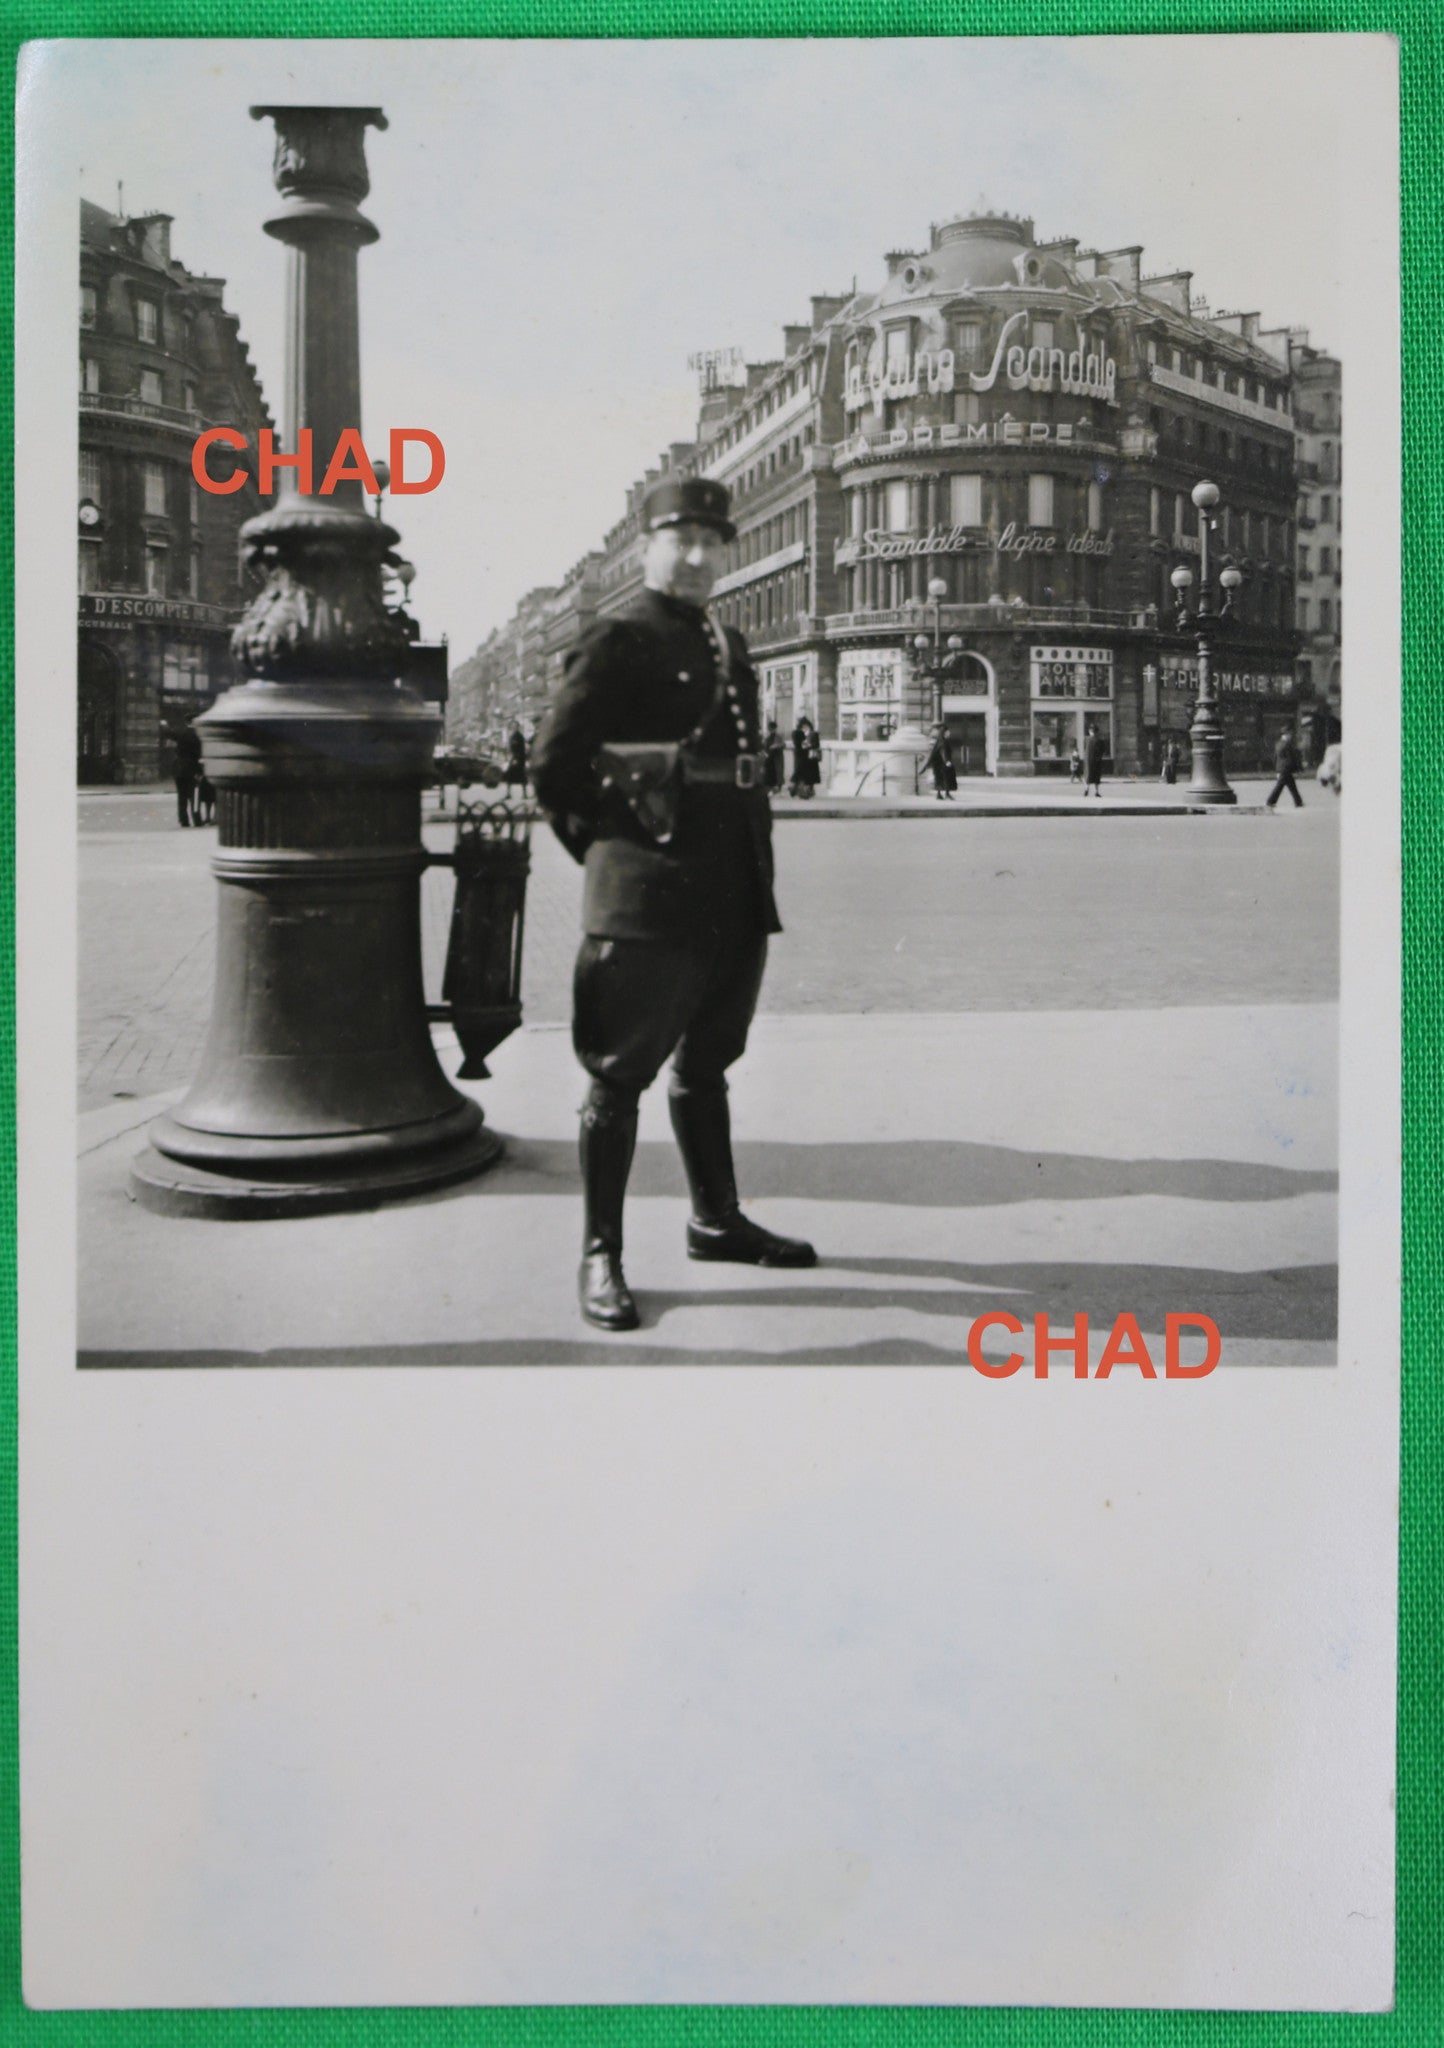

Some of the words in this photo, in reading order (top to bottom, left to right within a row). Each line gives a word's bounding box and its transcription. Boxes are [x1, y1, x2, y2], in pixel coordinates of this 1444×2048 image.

[969, 309, 1116, 400] Scandale
[860, 522, 967, 560] Scandale
[997, 521, 1056, 562] ligne
[95, 598, 190, 619] D'ESCOMPTE
[1039, 663, 1110, 677] HOLAND
[1039, 675, 1110, 688] AMEICA
[1177, 670, 1265, 693] PHRMACIE
